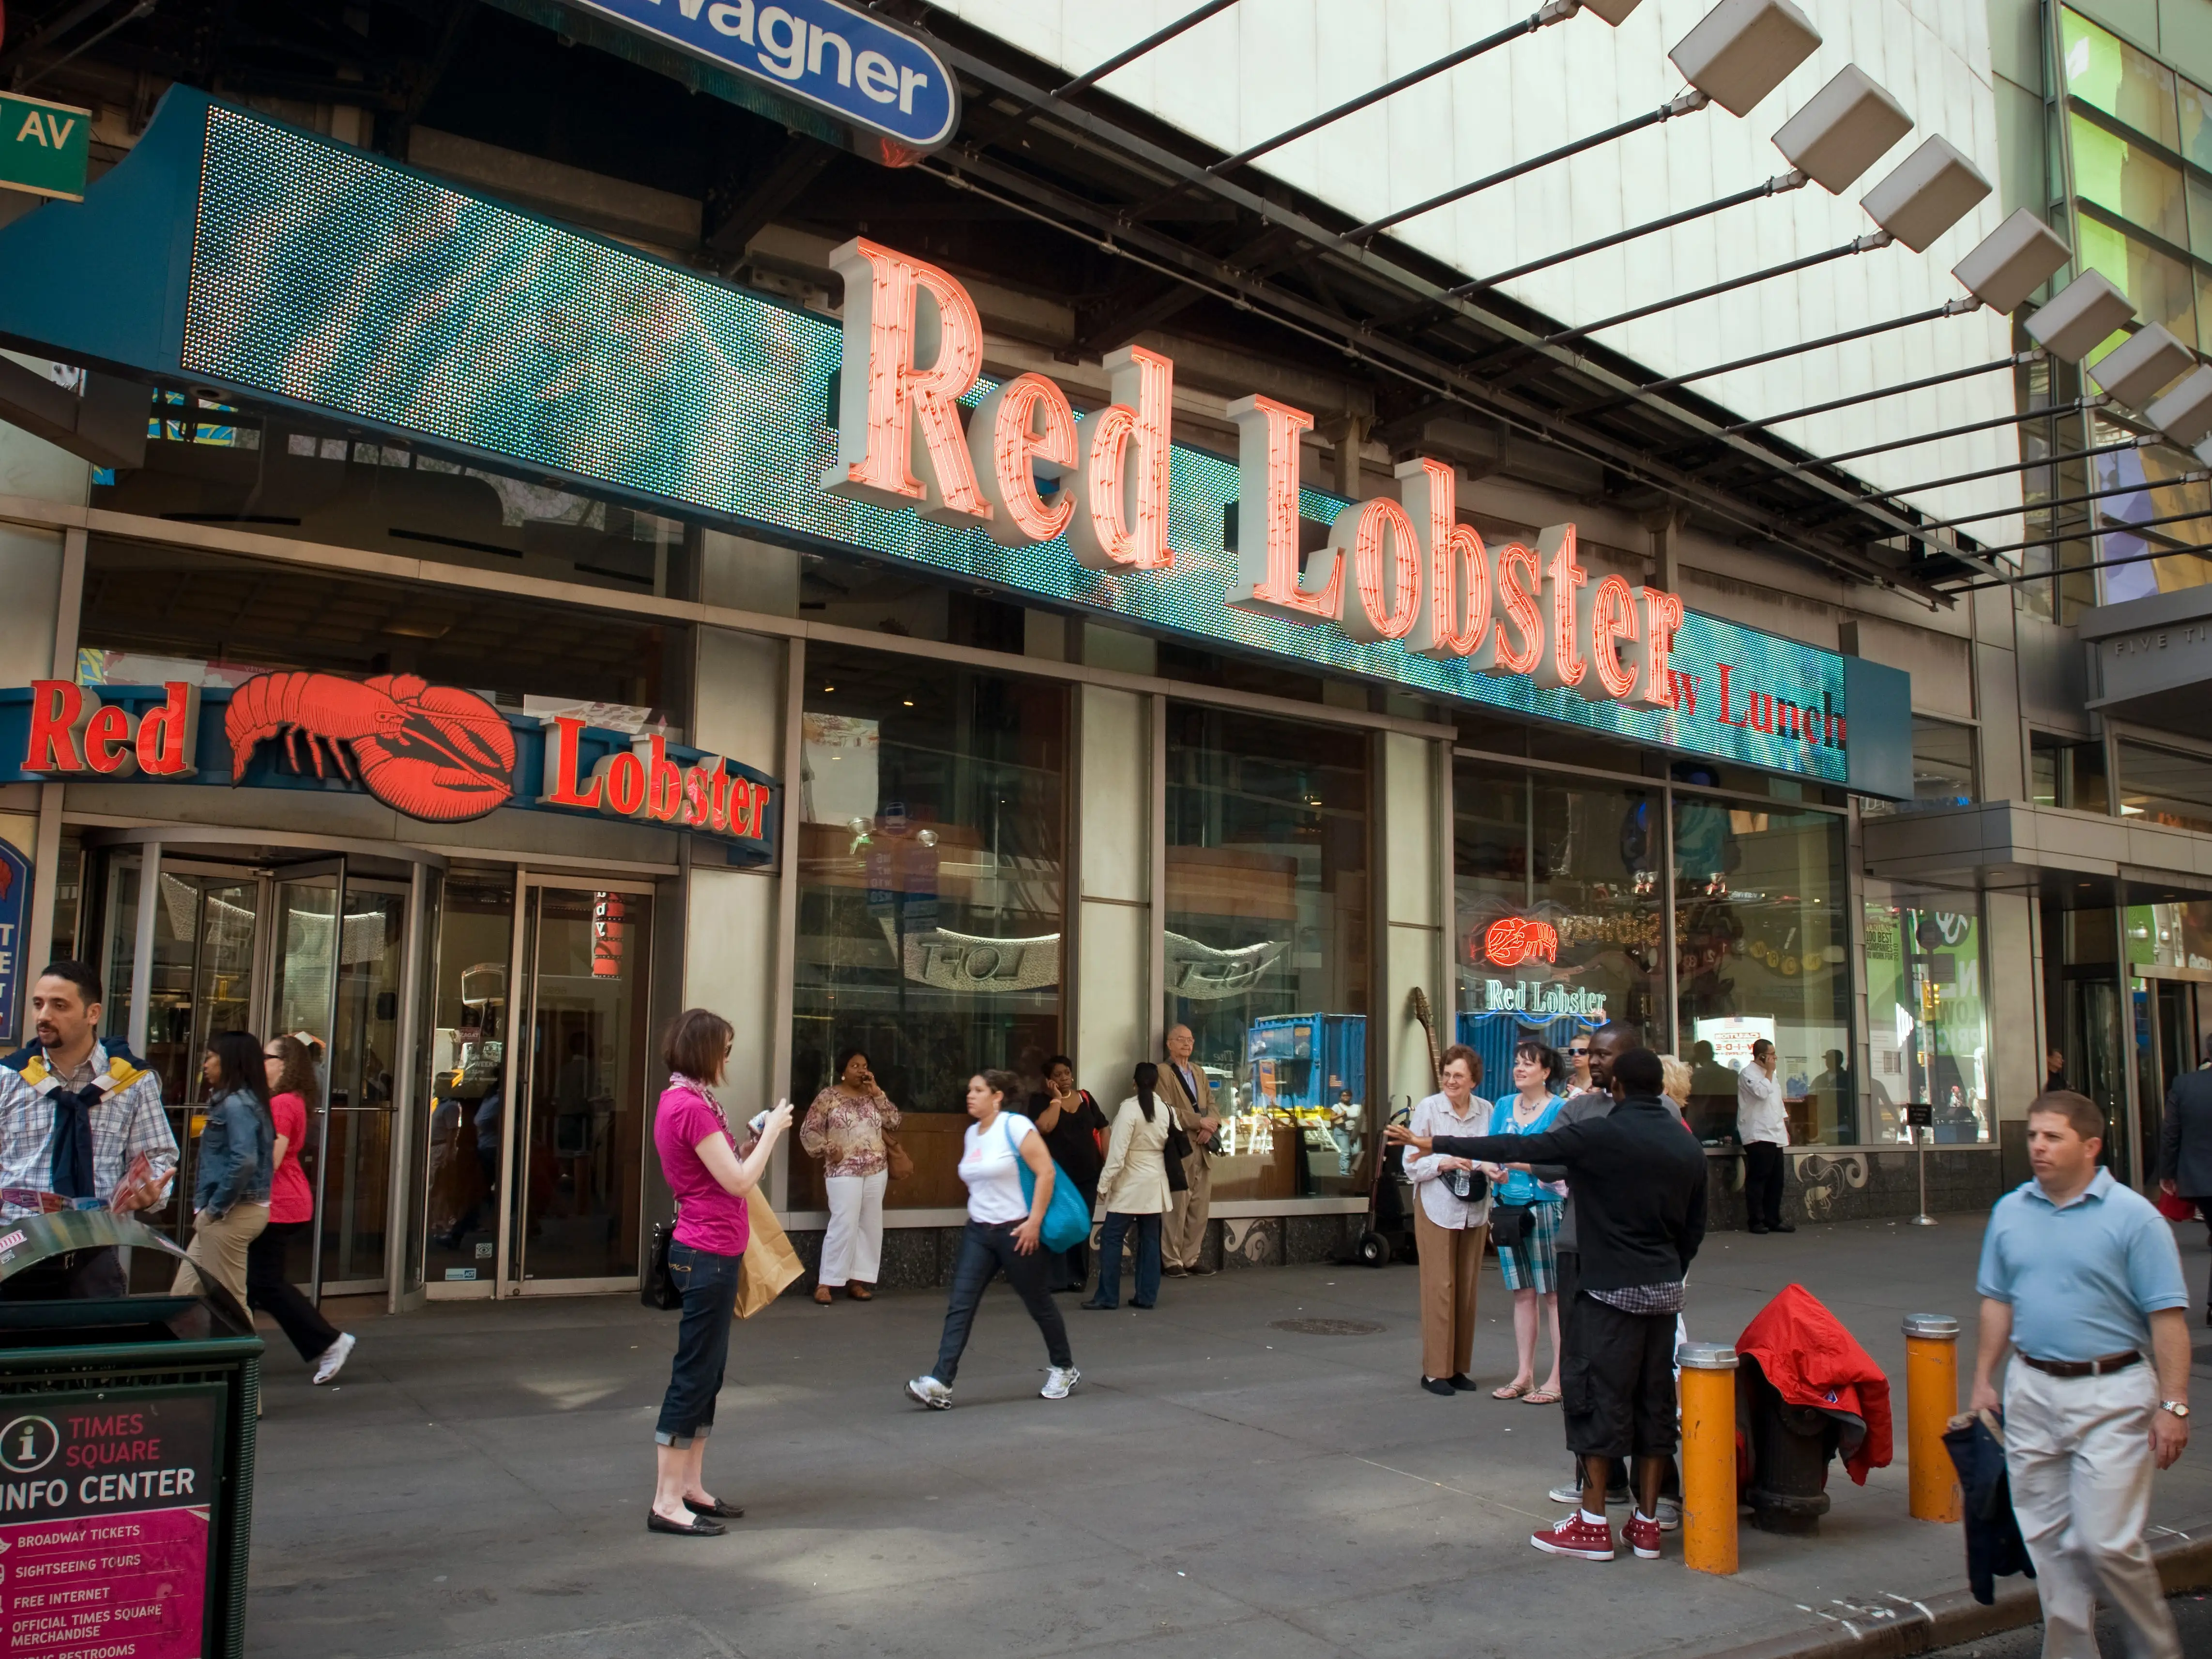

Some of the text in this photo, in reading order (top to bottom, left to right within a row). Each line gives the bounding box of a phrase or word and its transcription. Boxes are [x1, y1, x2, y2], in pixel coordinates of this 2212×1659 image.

[16, 111, 75, 150] AV
[846, 236, 1684, 709] Red Lobster
[2115, 634, 2167, 657] FIVE
[1716, 662, 1846, 750] Lunch
[20, 679, 770, 840] Red Lobster
[1866, 931, 1892, 943] 100 BEST
[1485, 979, 1607, 1015] Red Lobster
[69, 1414, 144, 1439] TIMES
[66, 1439, 161, 1468] SQUARE
[0, 1468, 195, 1511] INFO CENTER
[17, 1525, 140, 1548] BROADWAY TICKETS
[15, 1554, 141, 1579] SIGHTSEEING TOURS
[14, 1587, 110, 1609] FREE INTERNET
[13, 1604, 162, 1633] OFFICIAL TIMES SQUARE
[11, 1625, 101, 1647] MERCHANDISE
